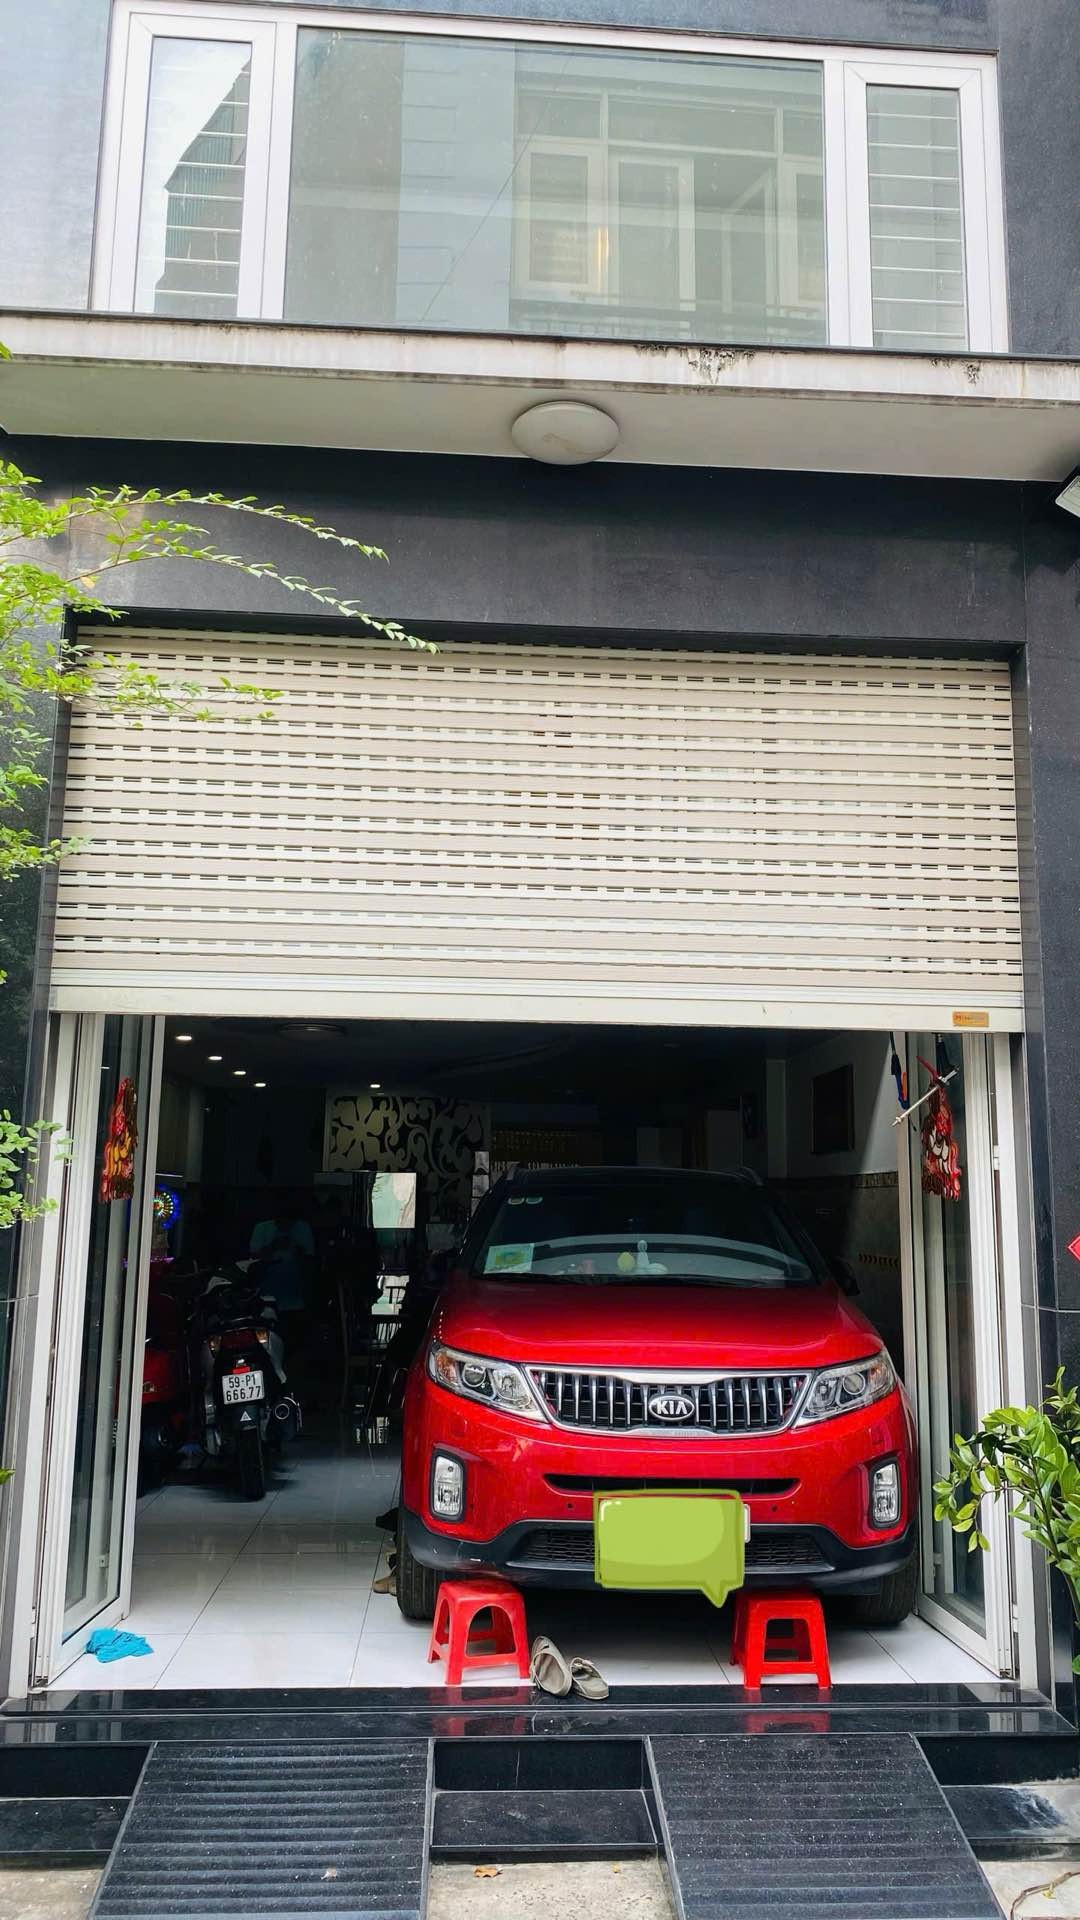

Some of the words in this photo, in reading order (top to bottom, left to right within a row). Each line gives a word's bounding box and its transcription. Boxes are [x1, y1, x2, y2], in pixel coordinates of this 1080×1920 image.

[229, 1375, 256, 1388] 59-P1
[226, 1386, 261, 1401] 666.77
[656, 1400, 688, 1415] KIA
